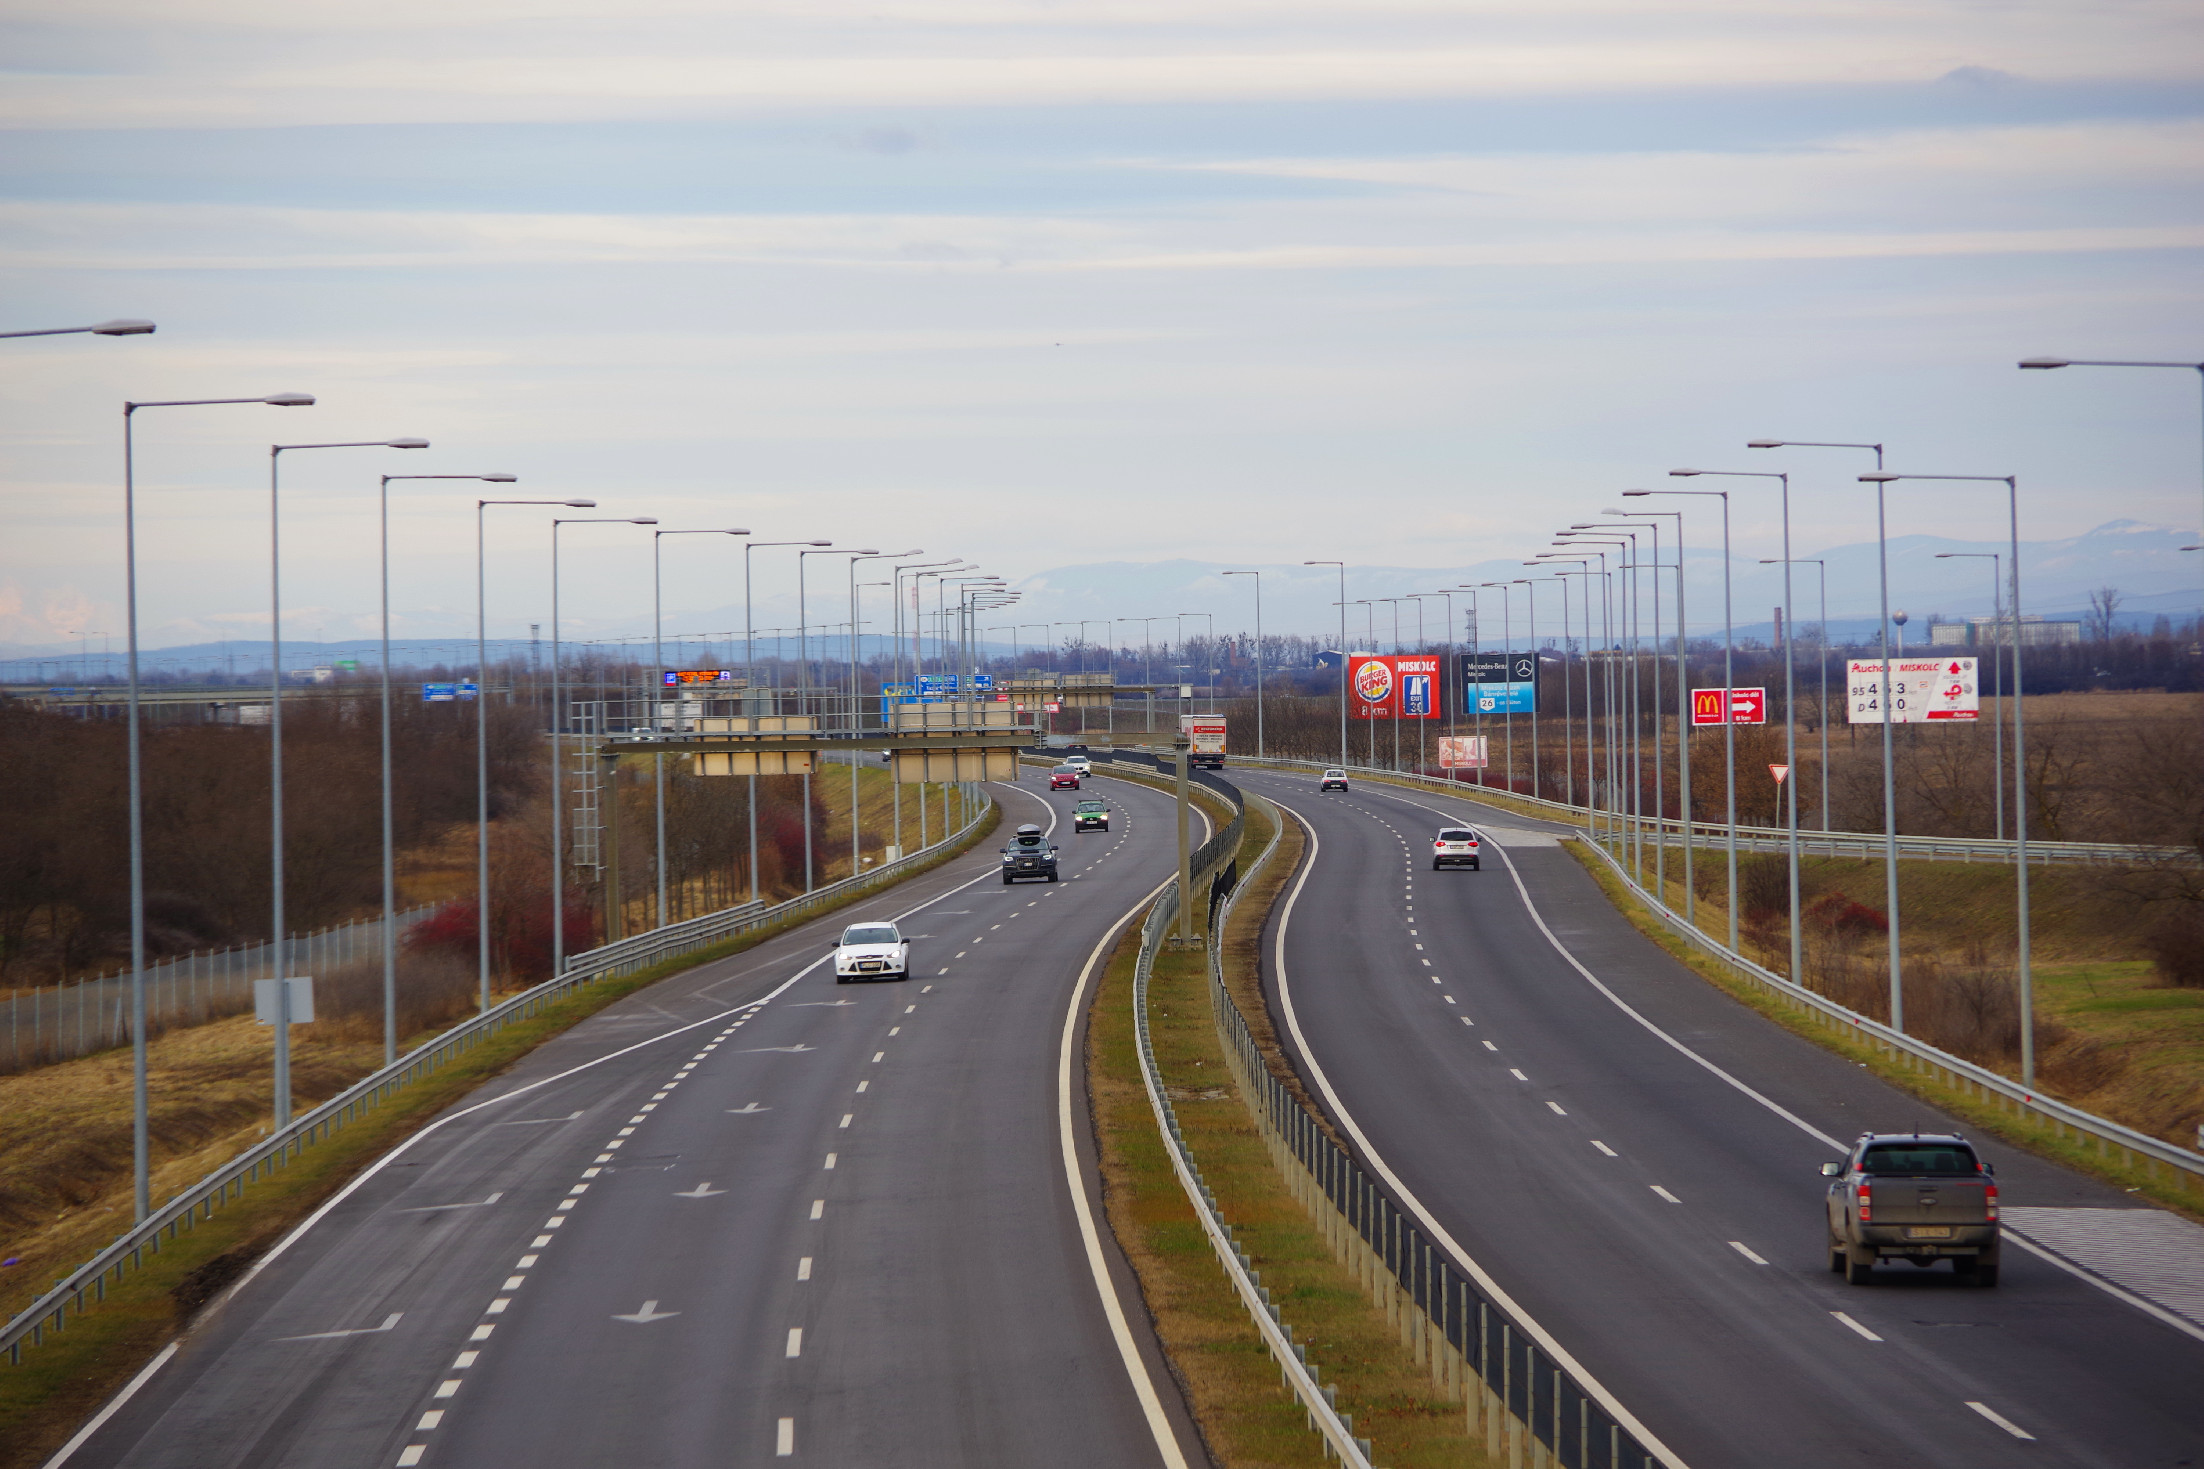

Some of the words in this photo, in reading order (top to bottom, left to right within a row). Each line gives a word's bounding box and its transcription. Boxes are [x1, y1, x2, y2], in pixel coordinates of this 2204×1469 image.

[1398, 661, 1436, 672] MISKOLC
[1899, 663, 1940, 672] MISKOLC
[1359, 669, 1387, 684] BURGER
[1361, 676, 1388, 693] KING
[1852, 687, 1865, 696] 95
[1858, 704, 1865, 712] D
